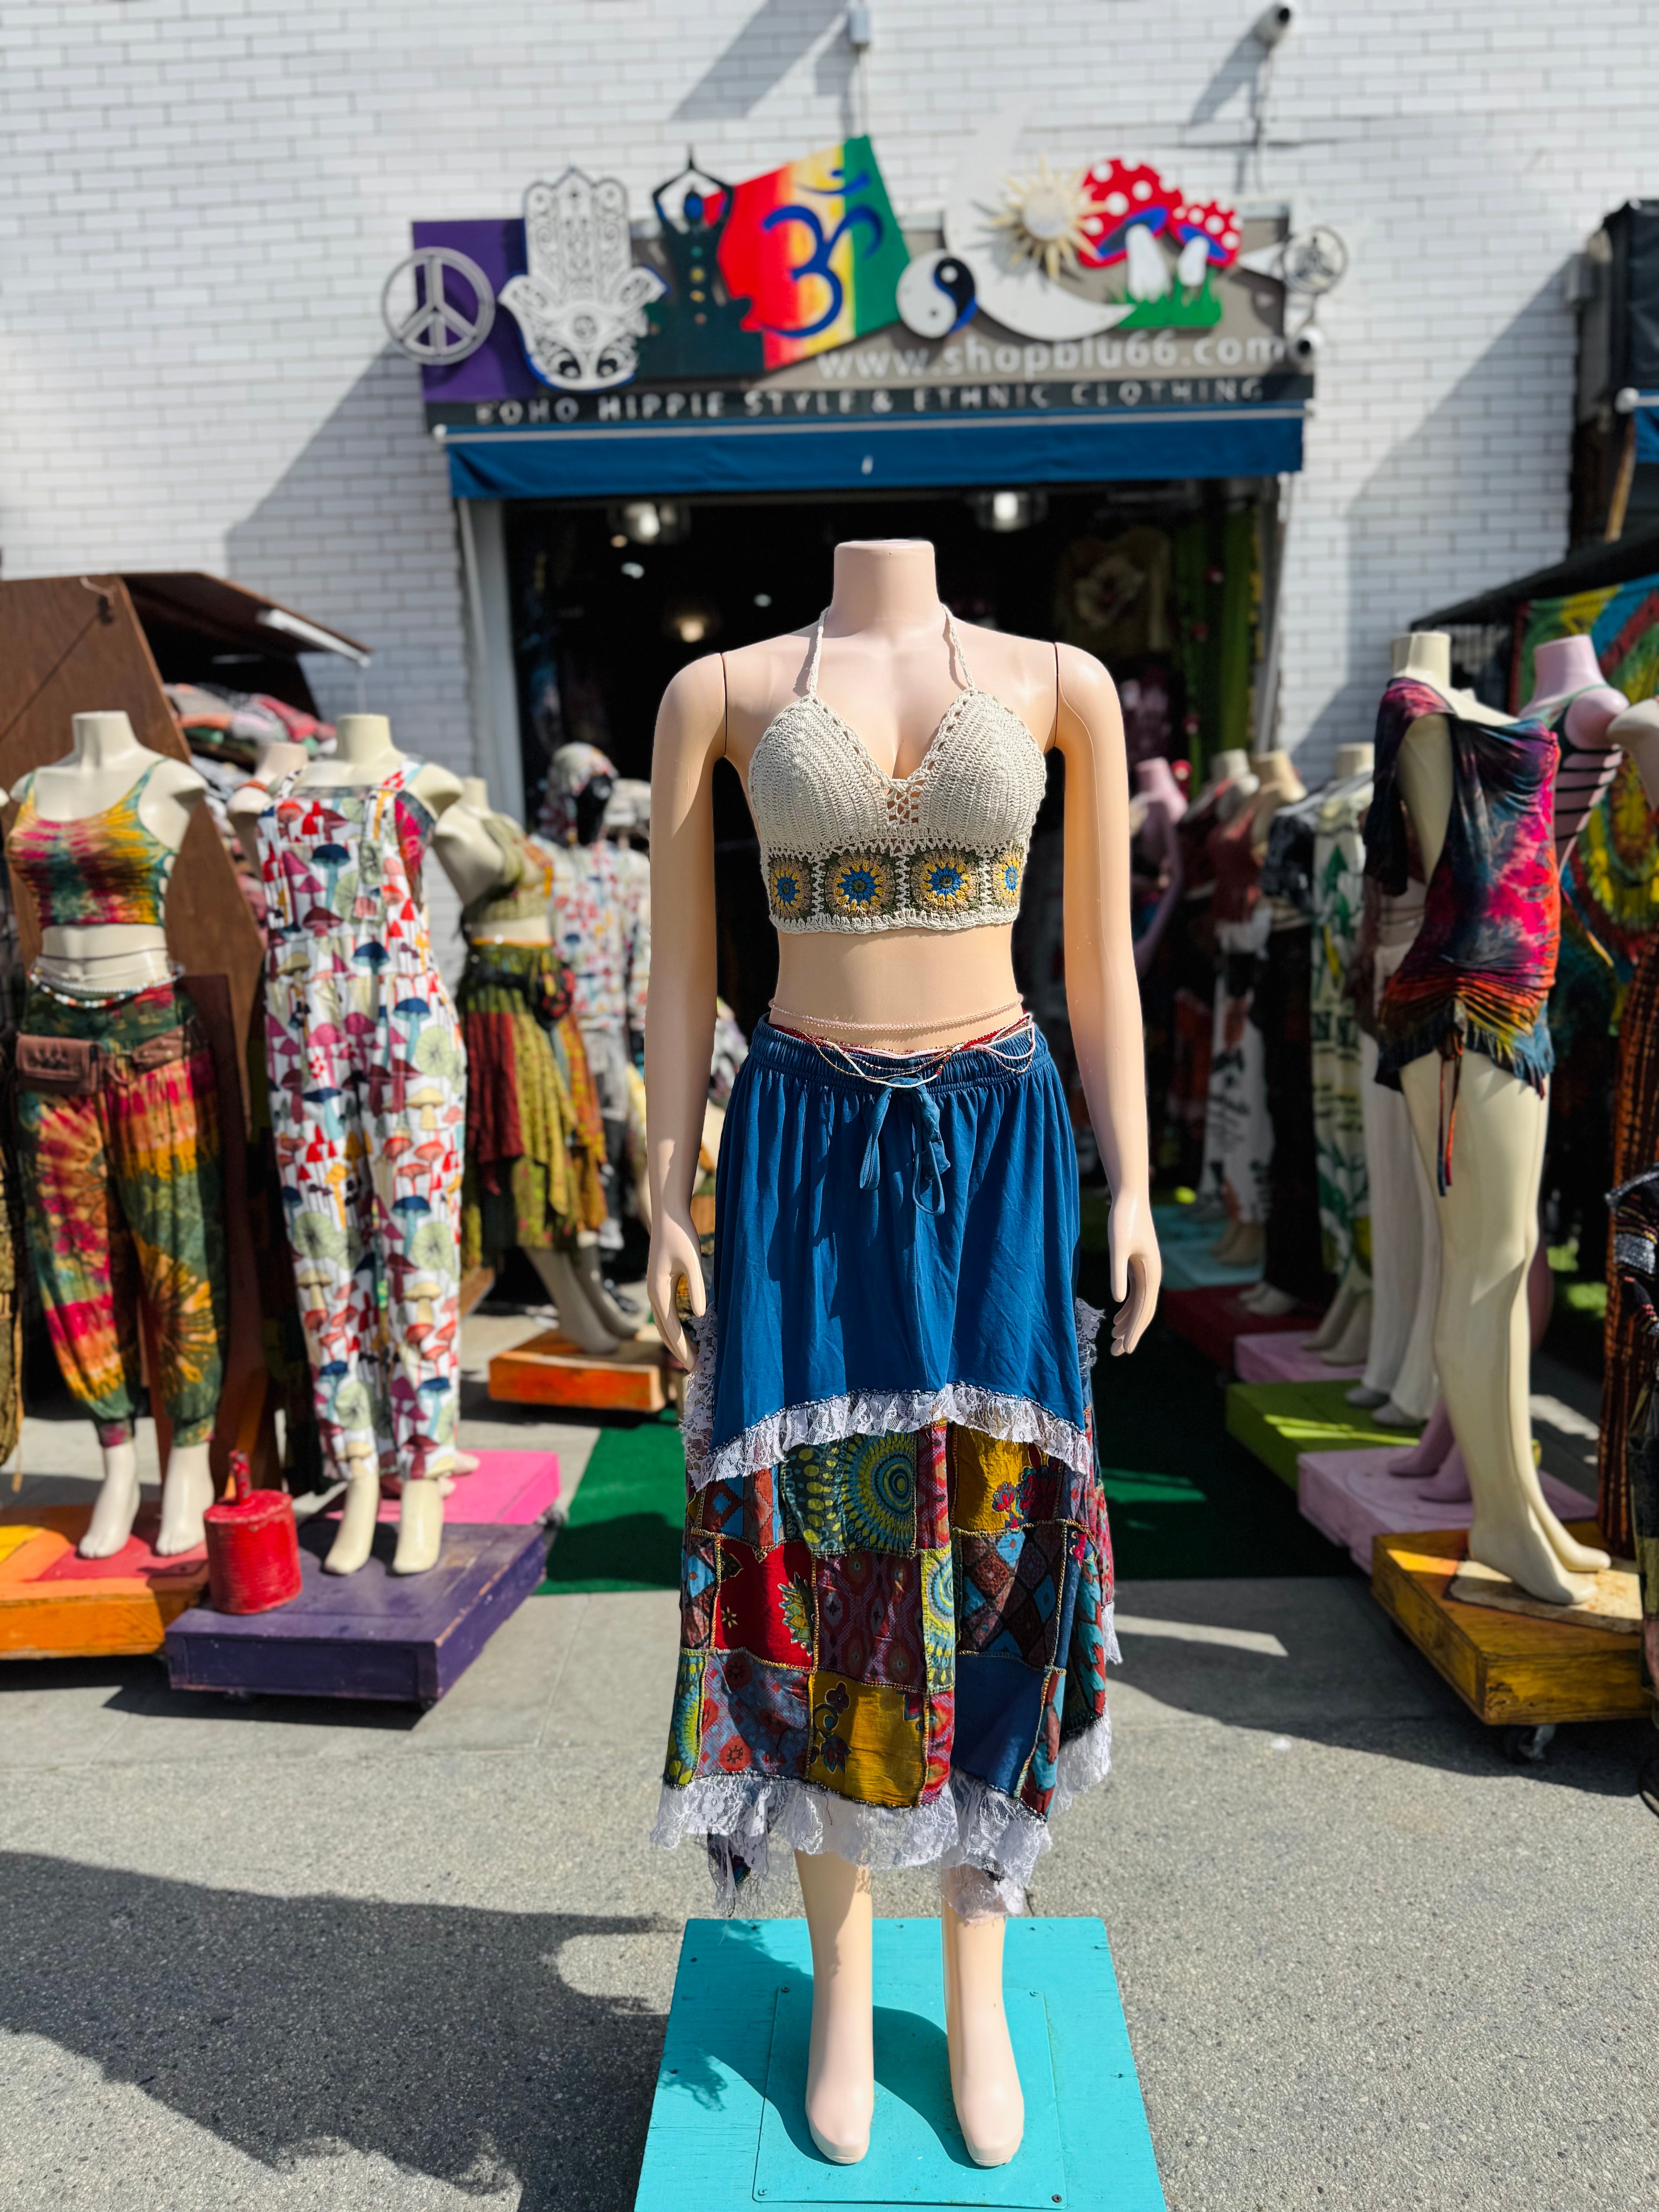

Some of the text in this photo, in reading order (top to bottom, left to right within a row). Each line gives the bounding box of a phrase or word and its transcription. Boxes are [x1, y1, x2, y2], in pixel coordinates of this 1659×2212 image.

[816, 330, 1285, 380] www.shopblu66.com
[476, 377, 1263, 426] BOHO HIPPIE STYLE & ETHNIC CLOTHING
